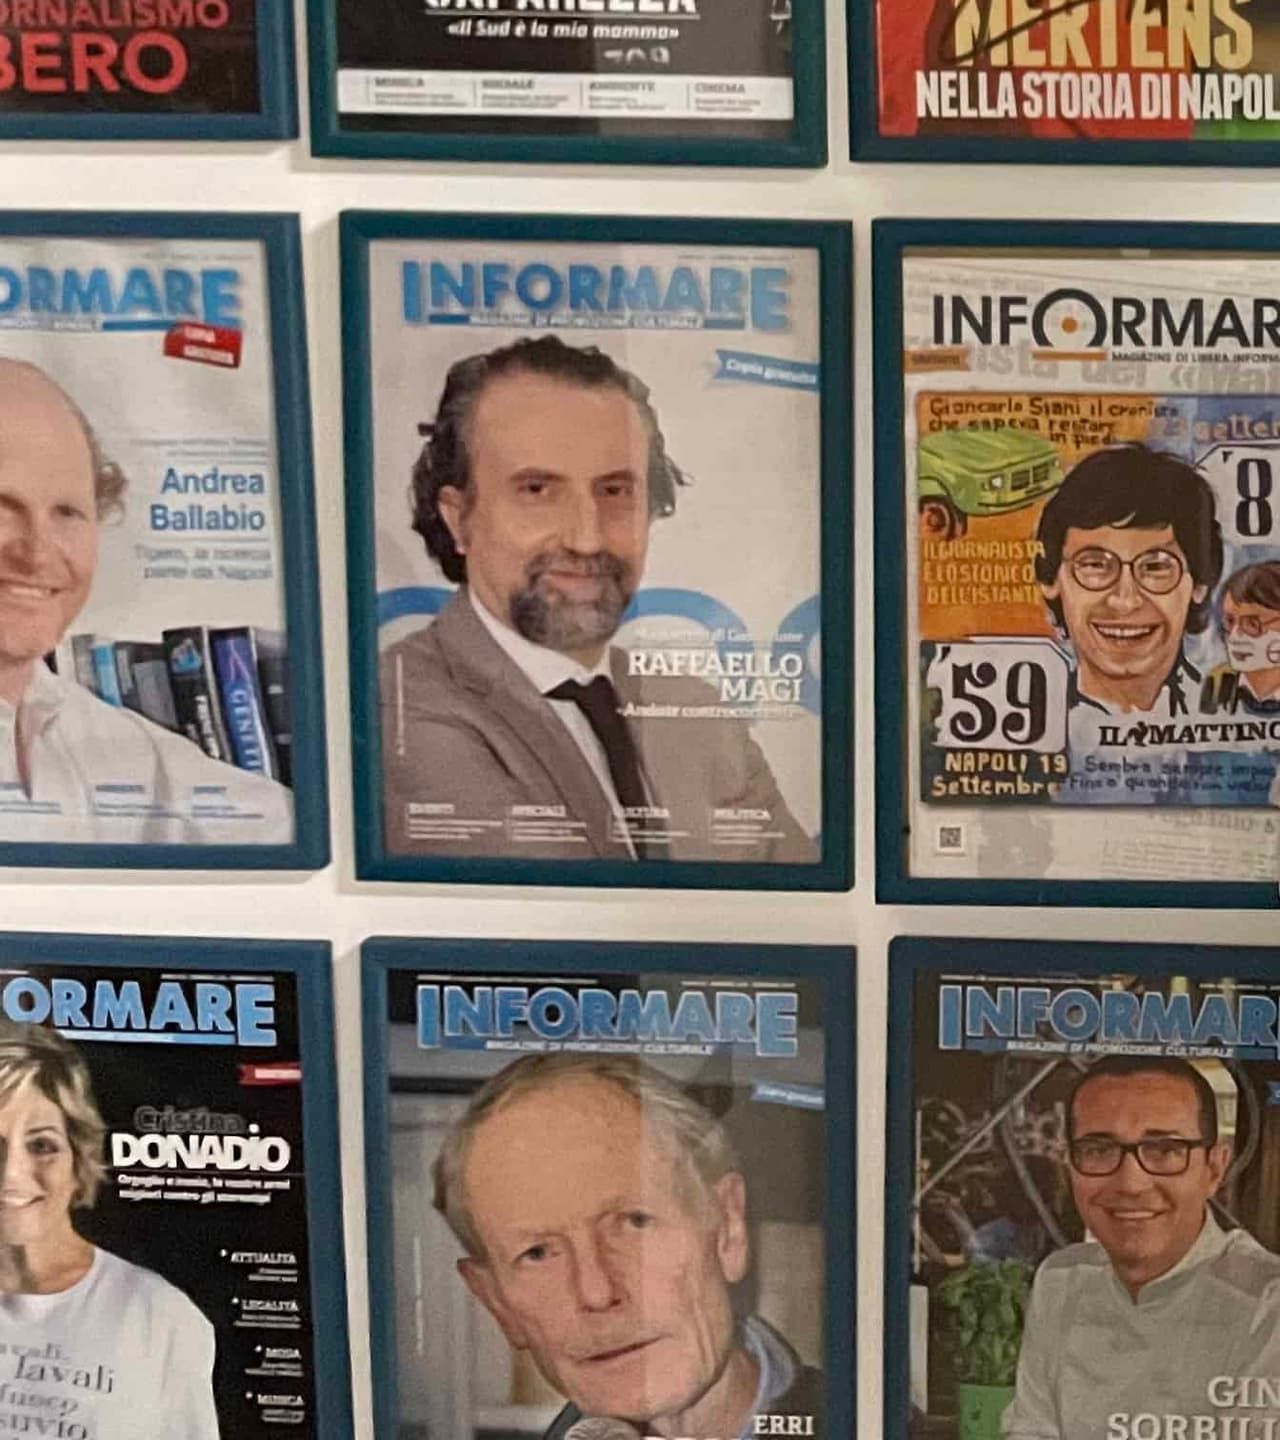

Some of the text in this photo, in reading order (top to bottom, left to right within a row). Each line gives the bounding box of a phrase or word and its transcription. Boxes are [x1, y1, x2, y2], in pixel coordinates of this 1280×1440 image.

[476, 19, 588, 38] Sud la mia
[915, 70, 1017, 118] NELLA
[1022, 71, 1135, 120] STORIA
[1140, 73, 1172, 119] DI
[402, 260, 791, 332] INFORMARE
[1111, 352, 1187, 362] MAGAZINE DI
[1029, 399, 1082, 417] Siani
[160, 467, 265, 494] Andrea
[149, 503, 266, 532] Ballabio
[627, 649, 803, 678] RAFFAELLO
[719, 678, 802, 703] MAGI
[946, 752, 1068, 773] NAPOLI 19
[932, 776, 1062, 796] Settembre
[416, 985, 798, 1057] INFORMARE
[133, 1105, 245, 1135] Cristina
[753, 1414, 814, 1436] ERRI
